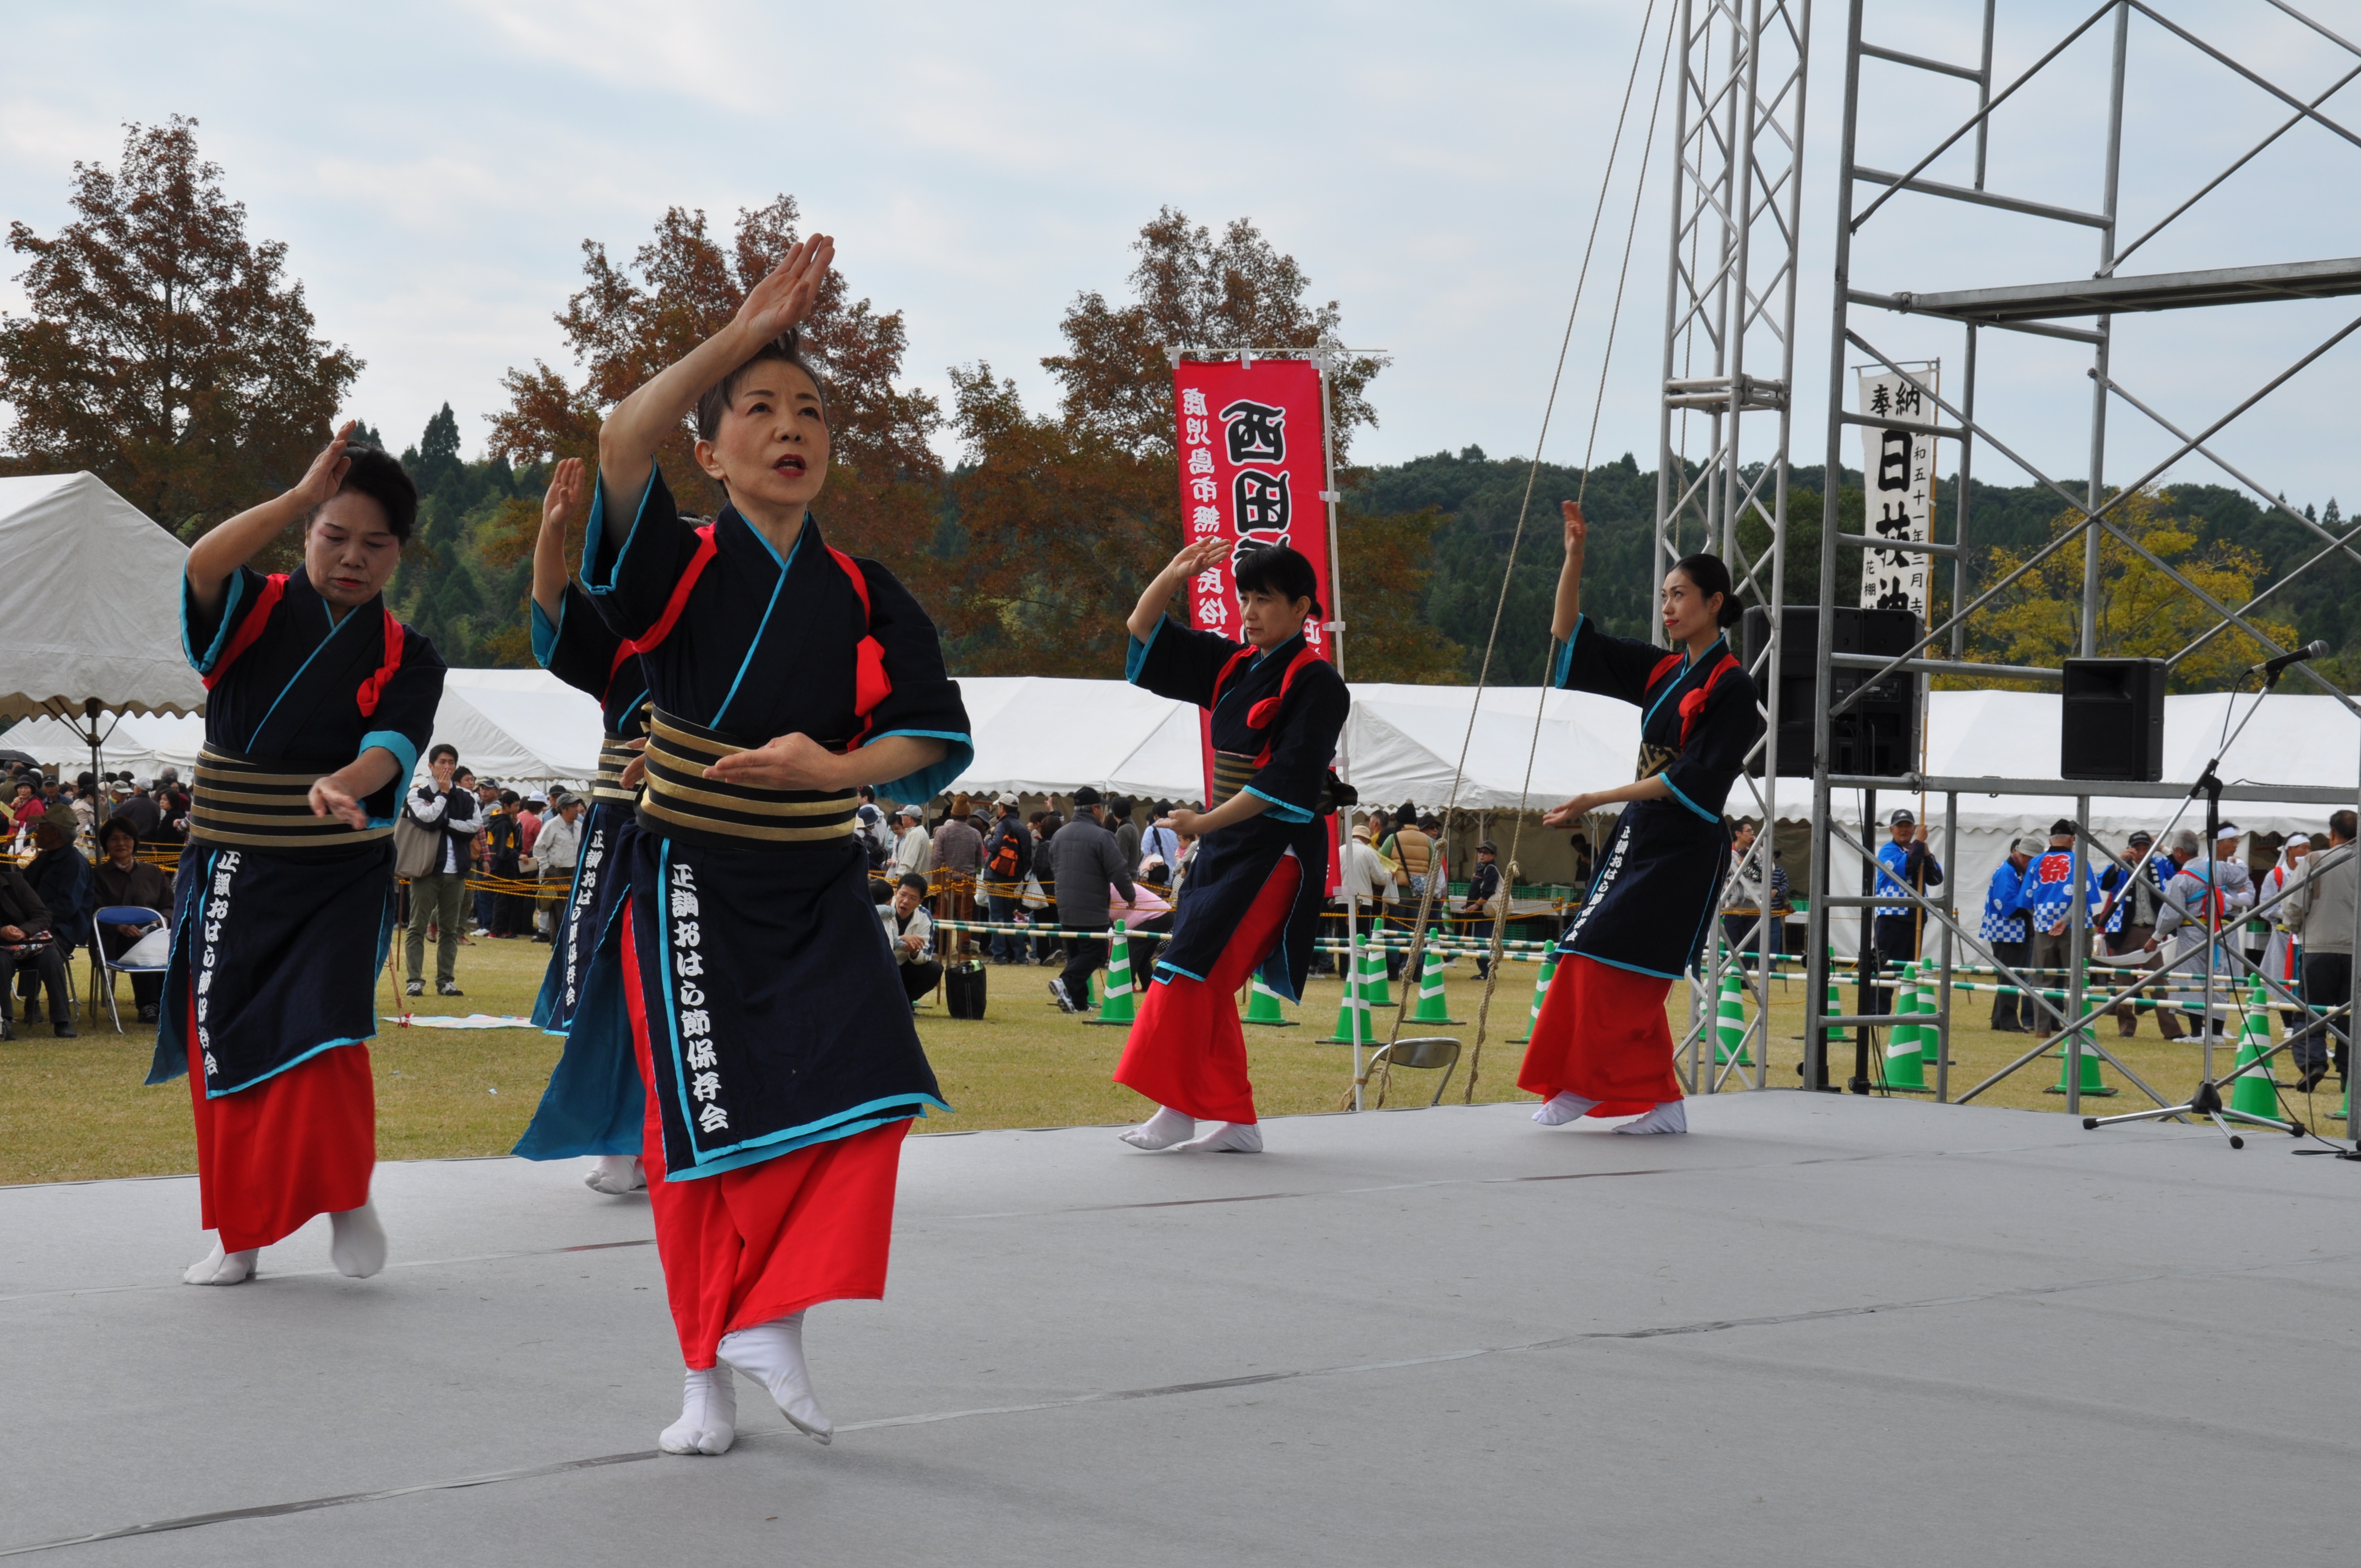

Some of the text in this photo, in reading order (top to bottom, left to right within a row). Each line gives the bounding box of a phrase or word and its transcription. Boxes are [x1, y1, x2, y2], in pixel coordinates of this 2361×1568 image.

[1870, 381, 1921, 418] 奉納
[2039, 853, 2071, 884] 祭
[671, 863, 729, 1133] 正調おはら節保存会
